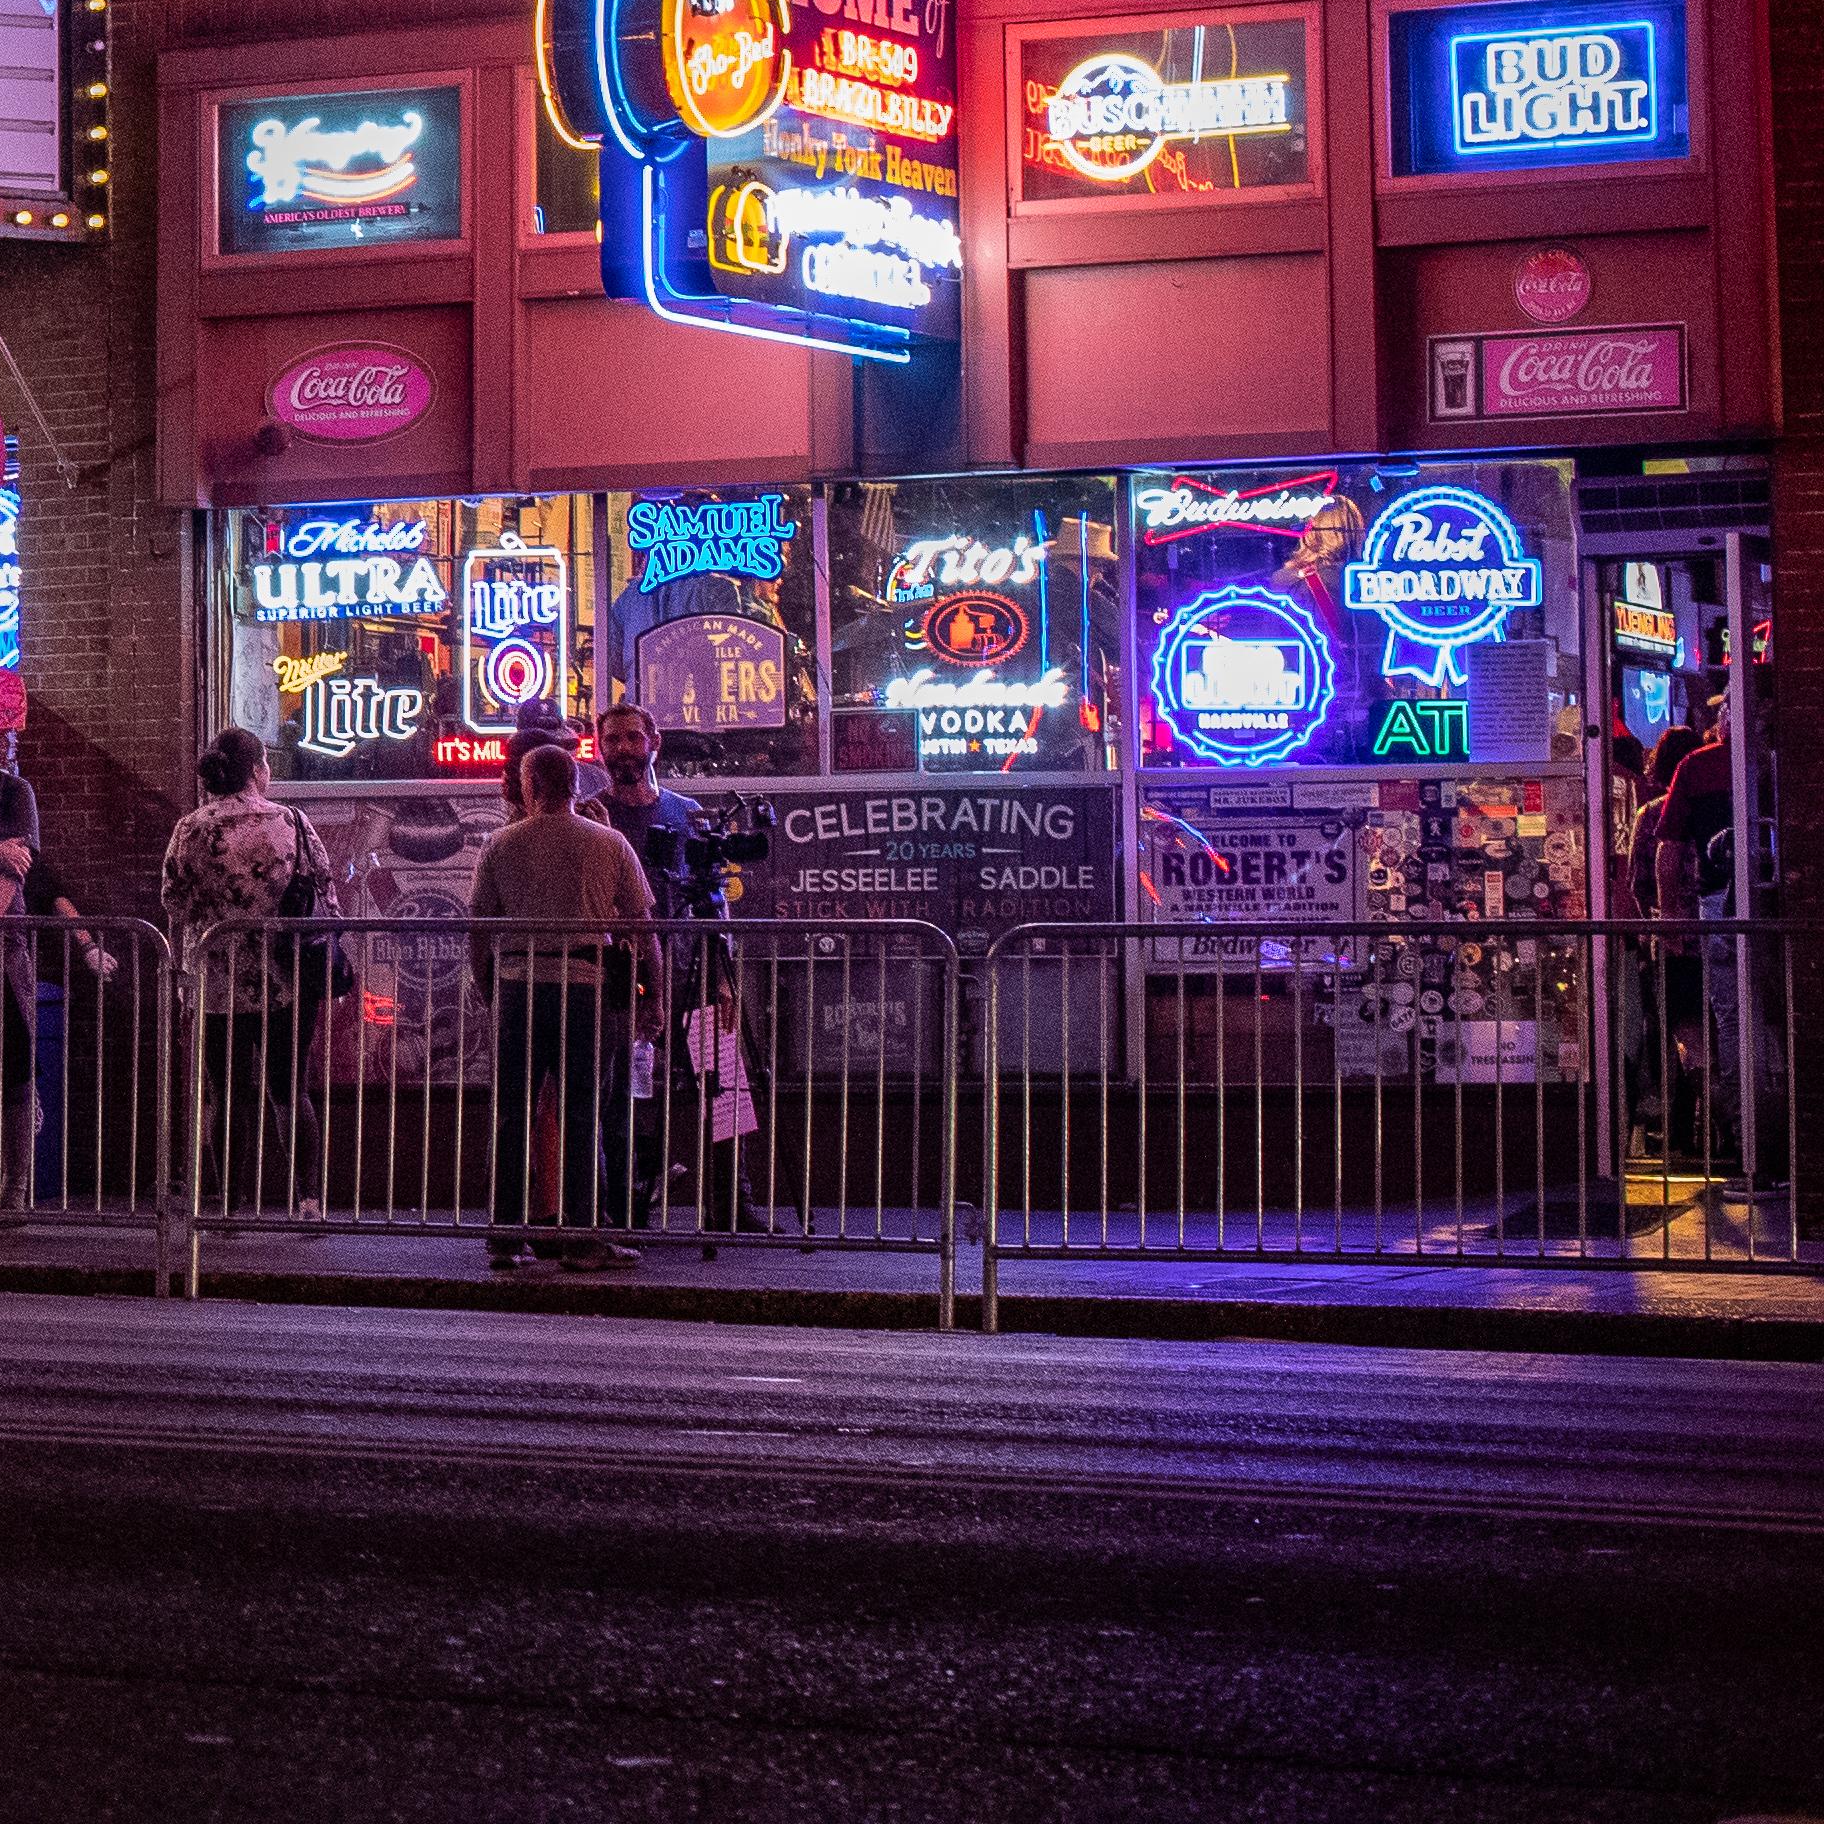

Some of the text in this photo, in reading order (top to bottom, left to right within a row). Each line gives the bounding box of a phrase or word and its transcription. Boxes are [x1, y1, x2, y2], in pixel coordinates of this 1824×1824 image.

[1487, 35, 1620, 91] BUD
[1089, 134, 1137, 152] BEER
[886, 144, 958, 198] Heaven
[264, 205, 406, 224] AMERICA'S OLDEST BREWERY
[290, 364, 410, 411] Coca-Cola
[1499, 339, 1658, 398] Coca-Cola
[1500, 390, 1663, 408] DELICIOUS AND REFRESHING
[288, 518, 427, 558] Michelob
[628, 494, 796, 550] SAMUEL
[1392, 513, 1492, 562] Pabst
[639, 539, 785, 594] ADAMS
[904, 534, 1052, 585] Tito's
[253, 556, 447, 609] ULTRA
[1357, 568, 1526, 604] BROADWAY
[256, 600, 444, 622] SUPERIOR LIGHT BEER
[470, 580, 562, 639] Lite
[1420, 604, 1473, 617] BEER
[272, 651, 348, 695] Miller
[296, 676, 424, 760] Lite
[920, 709, 1029, 735] VODKA
[438, 737, 471, 762] IT'S
[784, 796, 1075, 844] CELEBRATING
[1277, 833, 1298, 847] TO
[885, 840, 977, 863] 20 YEARS
[1162, 847, 1349, 887] ROBERT'S
[979, 866, 1096, 892] SADDLE
[1182, 887, 1258, 903] WESTERN
[774, 899, 849, 919] STICK
[866, 899, 930, 918] WITH
